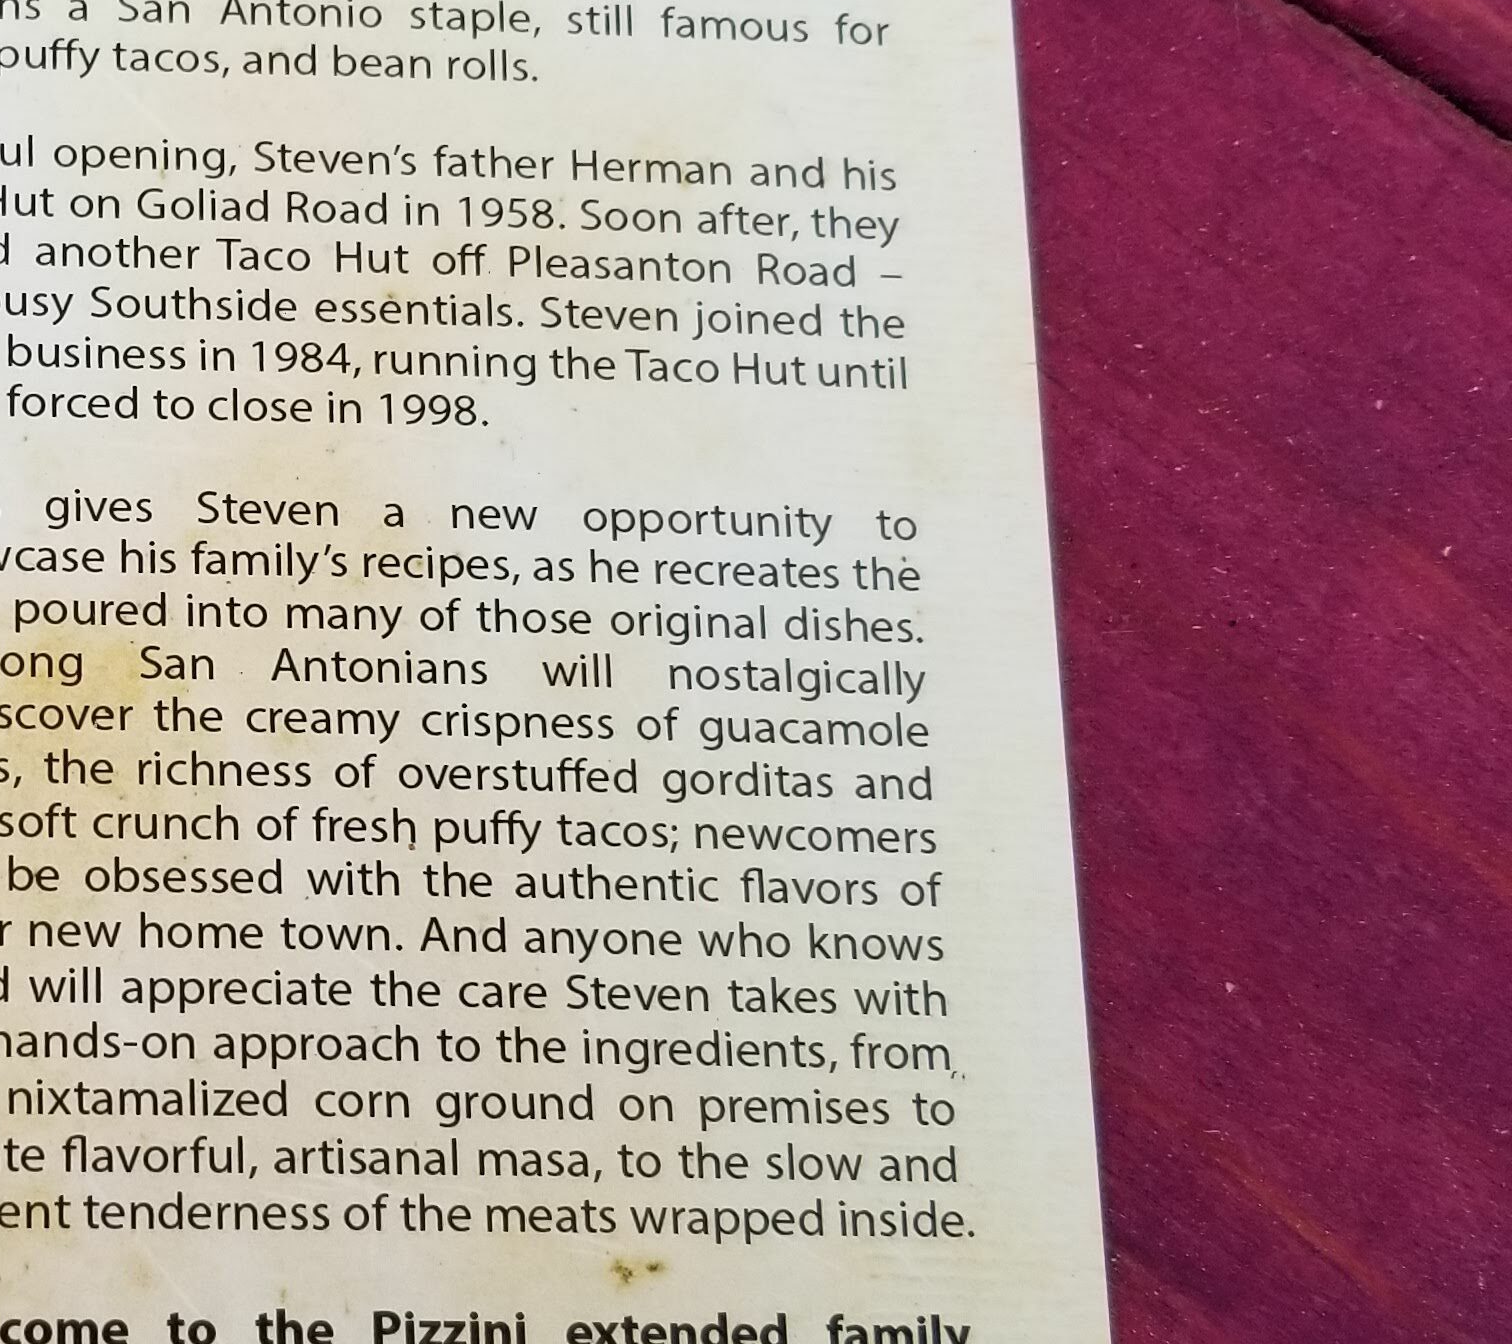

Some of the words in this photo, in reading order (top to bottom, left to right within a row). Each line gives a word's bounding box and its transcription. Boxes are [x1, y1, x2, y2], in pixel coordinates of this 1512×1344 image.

[411, 0, 540, 39] staple,
[568, 4, 632, 36] still
[661, 6, 808, 42] famous
[835, 13, 889, 46] for
[54, 139, 236, 179] opening,
[254, 141, 416, 175] Steven's
[433, 144, 554, 179] father
[572, 149, 731, 185] Herman
[750, 156, 825, 188] and
[843, 157, 896, 191] his
[91, 286, 297, 322] Southside
[315, 293, 524, 327] essentials.
[541, 296, 678, 332] Steven
[692, 301, 822, 340] joined
[840, 305, 905, 339] the
[6, 383, 138, 419] forced
[153, 390, 194, 420] to
[208, 387, 312, 422] close
[327, 391, 361, 424] in
[380, 393, 488, 427] 1998.
[45, 489, 152, 530] gives
[198, 491, 338, 526] Steven
[384, 503, 404, 528] a
[452, 504, 538, 530] new
[583, 505, 832, 547] opportunity
[876, 510, 917, 541] to
[140, 645, 214, 680] San
[271, 648, 487, 685] Antonians
[542, 653, 612, 688] will
[669, 658, 926, 704] nostalgically
[44, 748, 114, 785] the
[138, 750, 311, 787] richness
[335, 753, 377, 788] of
[399, 757, 637, 794] overstuffed
[663, 761, 833, 803] gorditas
[855, 766, 932, 801] and
[29, 920, 121, 948] new
[140, 911, 263, 949] home
[280, 917, 403, 951] town.
[420, 916, 506, 953] And
[524, 928, 682, 963] anyone
[698, 921, 790, 958] who
[809, 923, 944, 961] knows
[8, 1078, 287, 1117] nixtamalized
[315, 1091, 410, 1118] corn
[436, 1083, 594, 1128] ground
[619, 1095, 673, 1122] on
[700, 1089, 890, 1132] premises
[912, 1093, 955, 1126] to
[83, 1191, 330, 1231] tenderness
[344, 1193, 389, 1231] of
[400, 1193, 471, 1232] the
[486, 1199, 616, 1233] meats
[630, 1198, 824, 1245] wrapped
[838, 1200, 975, 1238] inside.
